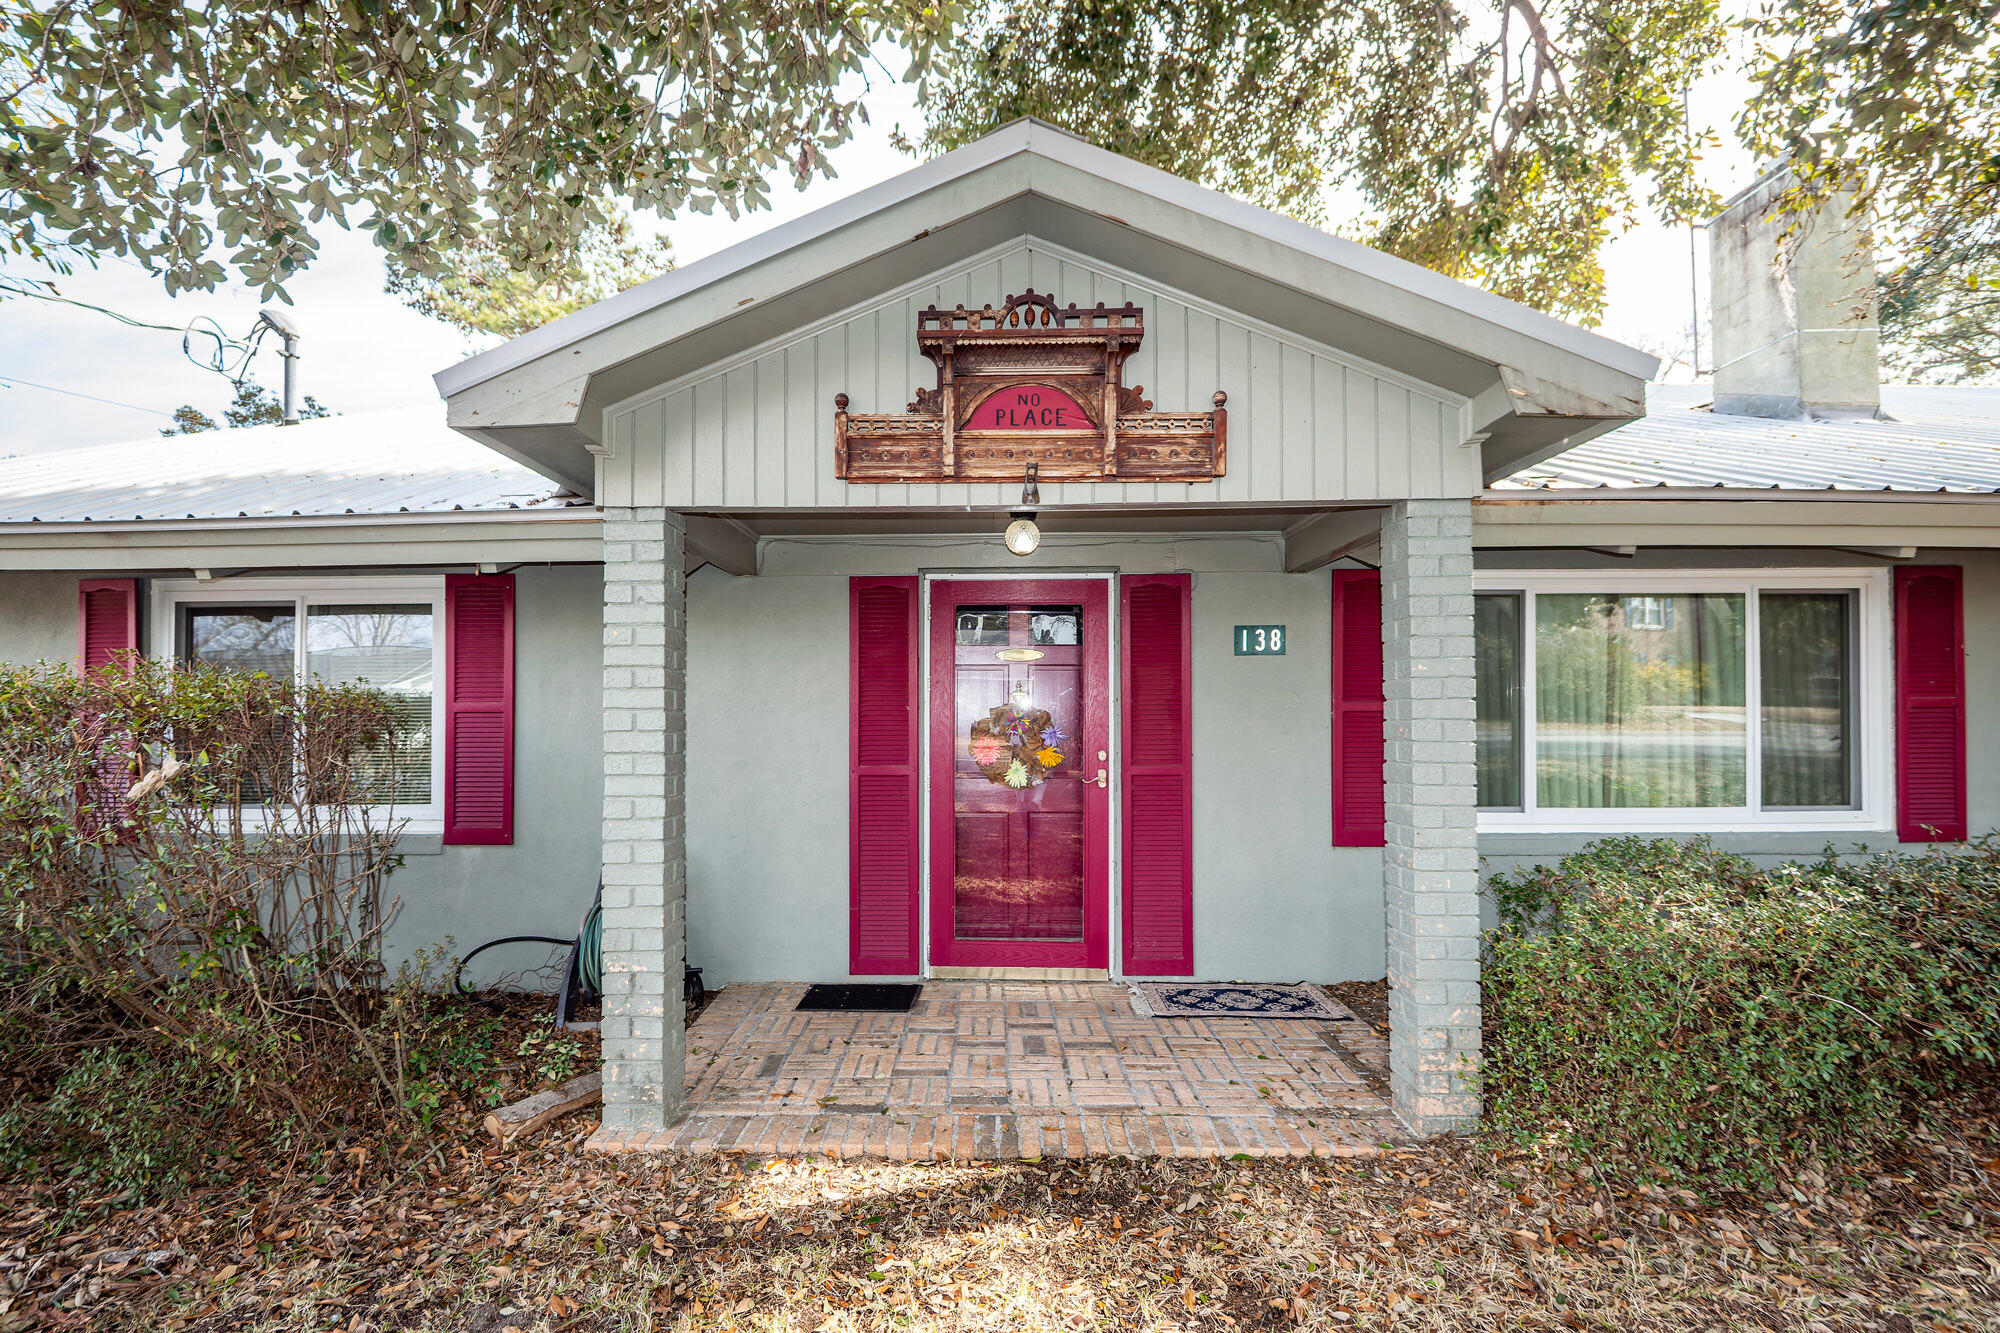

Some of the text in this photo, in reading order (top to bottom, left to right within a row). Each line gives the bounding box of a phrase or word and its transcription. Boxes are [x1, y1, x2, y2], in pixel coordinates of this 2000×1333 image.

[1018, 394, 1041, 407] NO
[996, 408, 1068, 427] PLACE
[1242, 629, 1281, 652] 138
